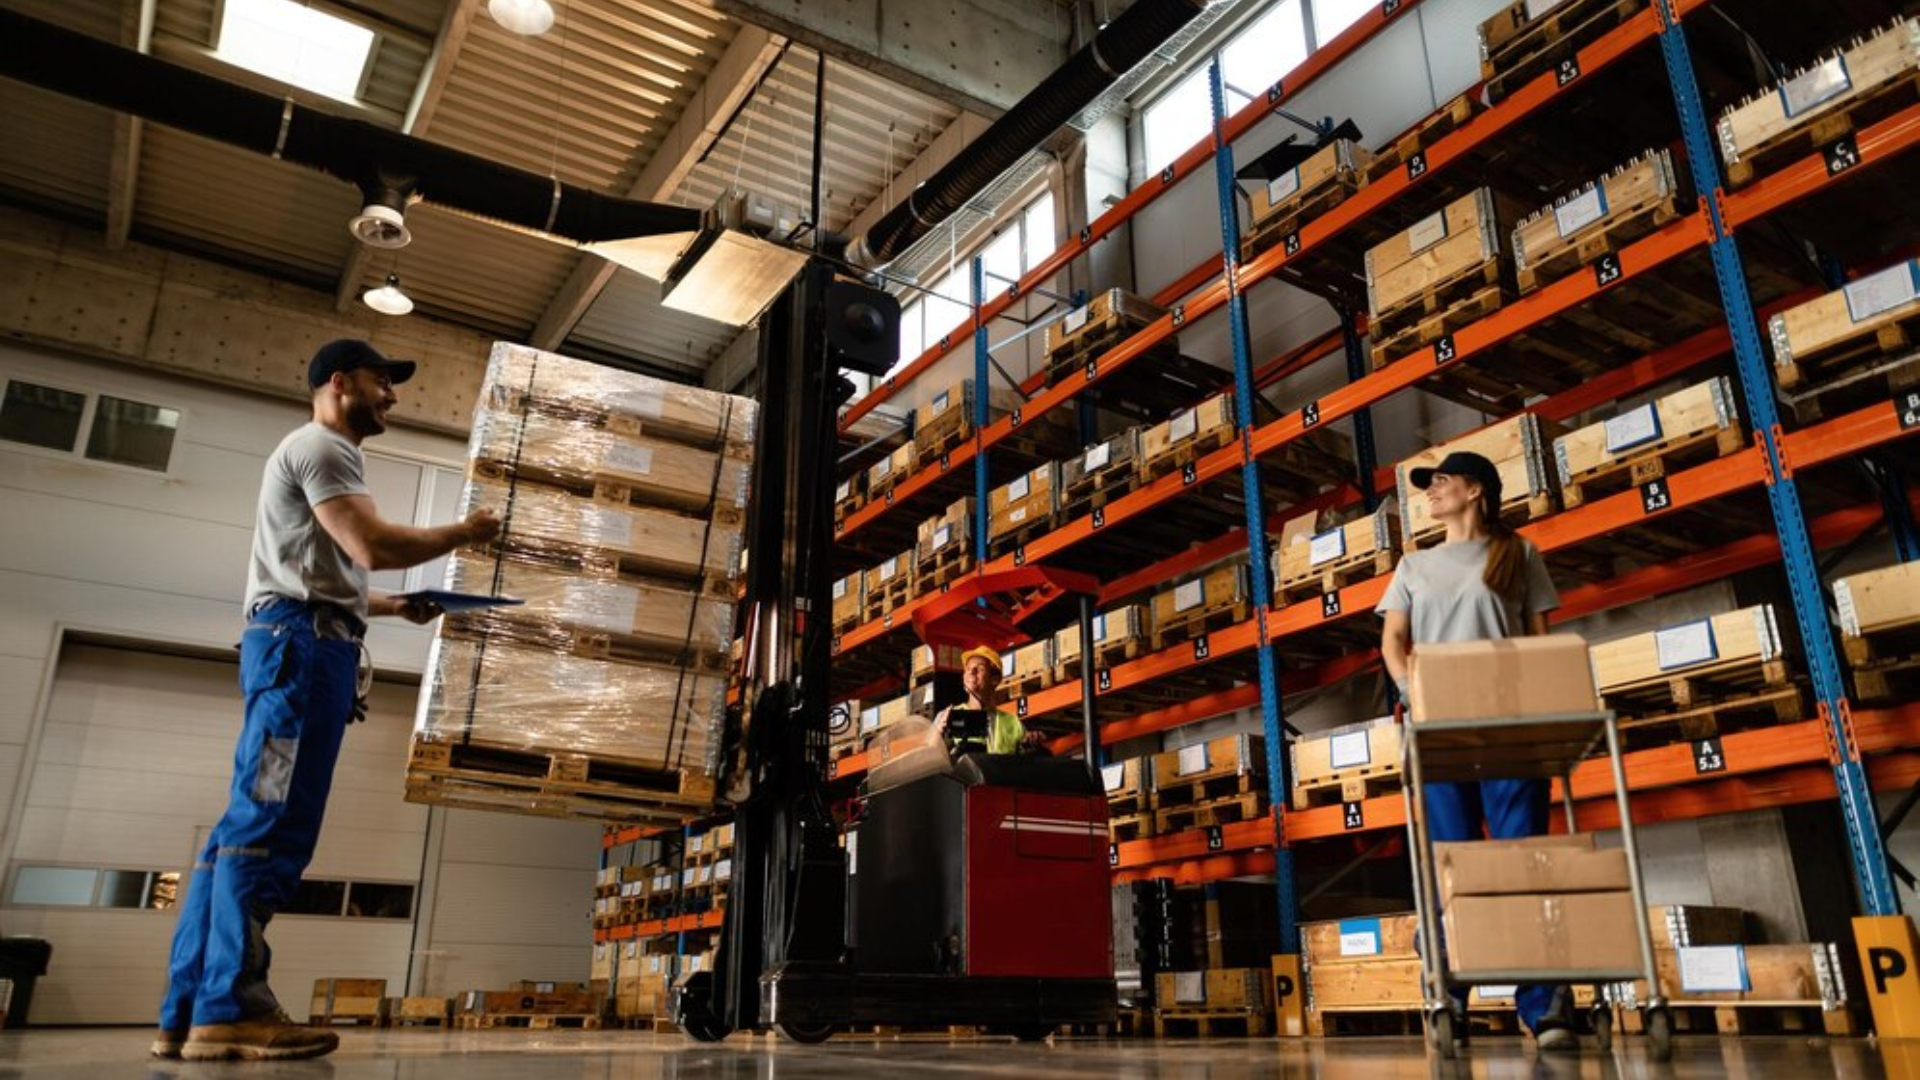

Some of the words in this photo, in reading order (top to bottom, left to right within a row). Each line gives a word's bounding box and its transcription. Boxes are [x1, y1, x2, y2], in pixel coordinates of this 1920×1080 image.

[1835, 142, 1846, 155] C
[1832, 152, 1855, 171] 6.1
[1603, 258, 1611, 269] C
[1439, 339, 1448, 349] C
[1907, 393, 1919, 408] B
[1307, 404, 1314, 414] C
[1904, 410, 1920, 425] 6.
[1649, 483, 1659, 495] B
[1647, 493, 1667, 510] 5.3
[1701, 740, 1712, 754] A
[1699, 755, 1722, 771] 5.3
[1349, 803, 1356, 814] A
[1347, 815, 1361, 827] 5.1
[1868, 947, 1907, 995] P
[1276, 975, 1294, 1007] P
